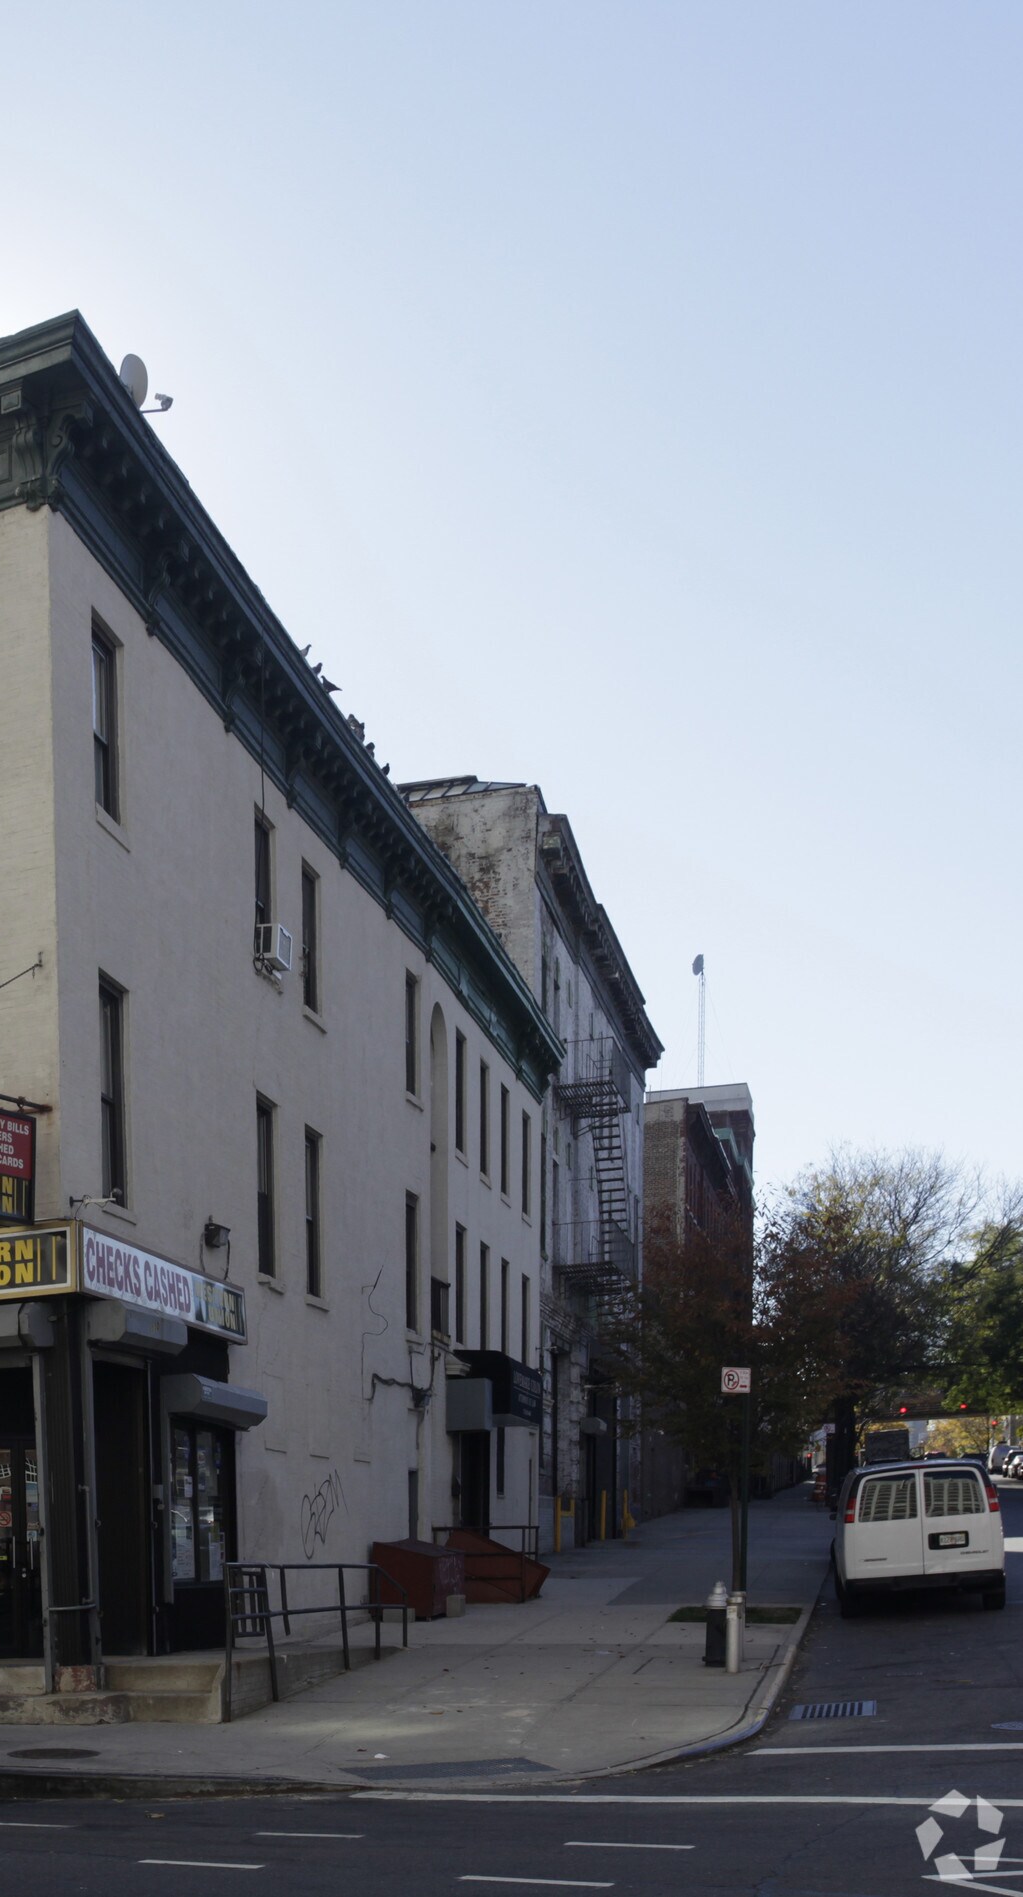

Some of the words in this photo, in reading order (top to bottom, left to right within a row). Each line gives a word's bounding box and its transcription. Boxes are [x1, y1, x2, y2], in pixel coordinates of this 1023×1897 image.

[7, 1121, 30, 1136] BILLS
[86, 1236, 142, 1298] CHECKS
[144, 1260, 192, 1314] CASHED
